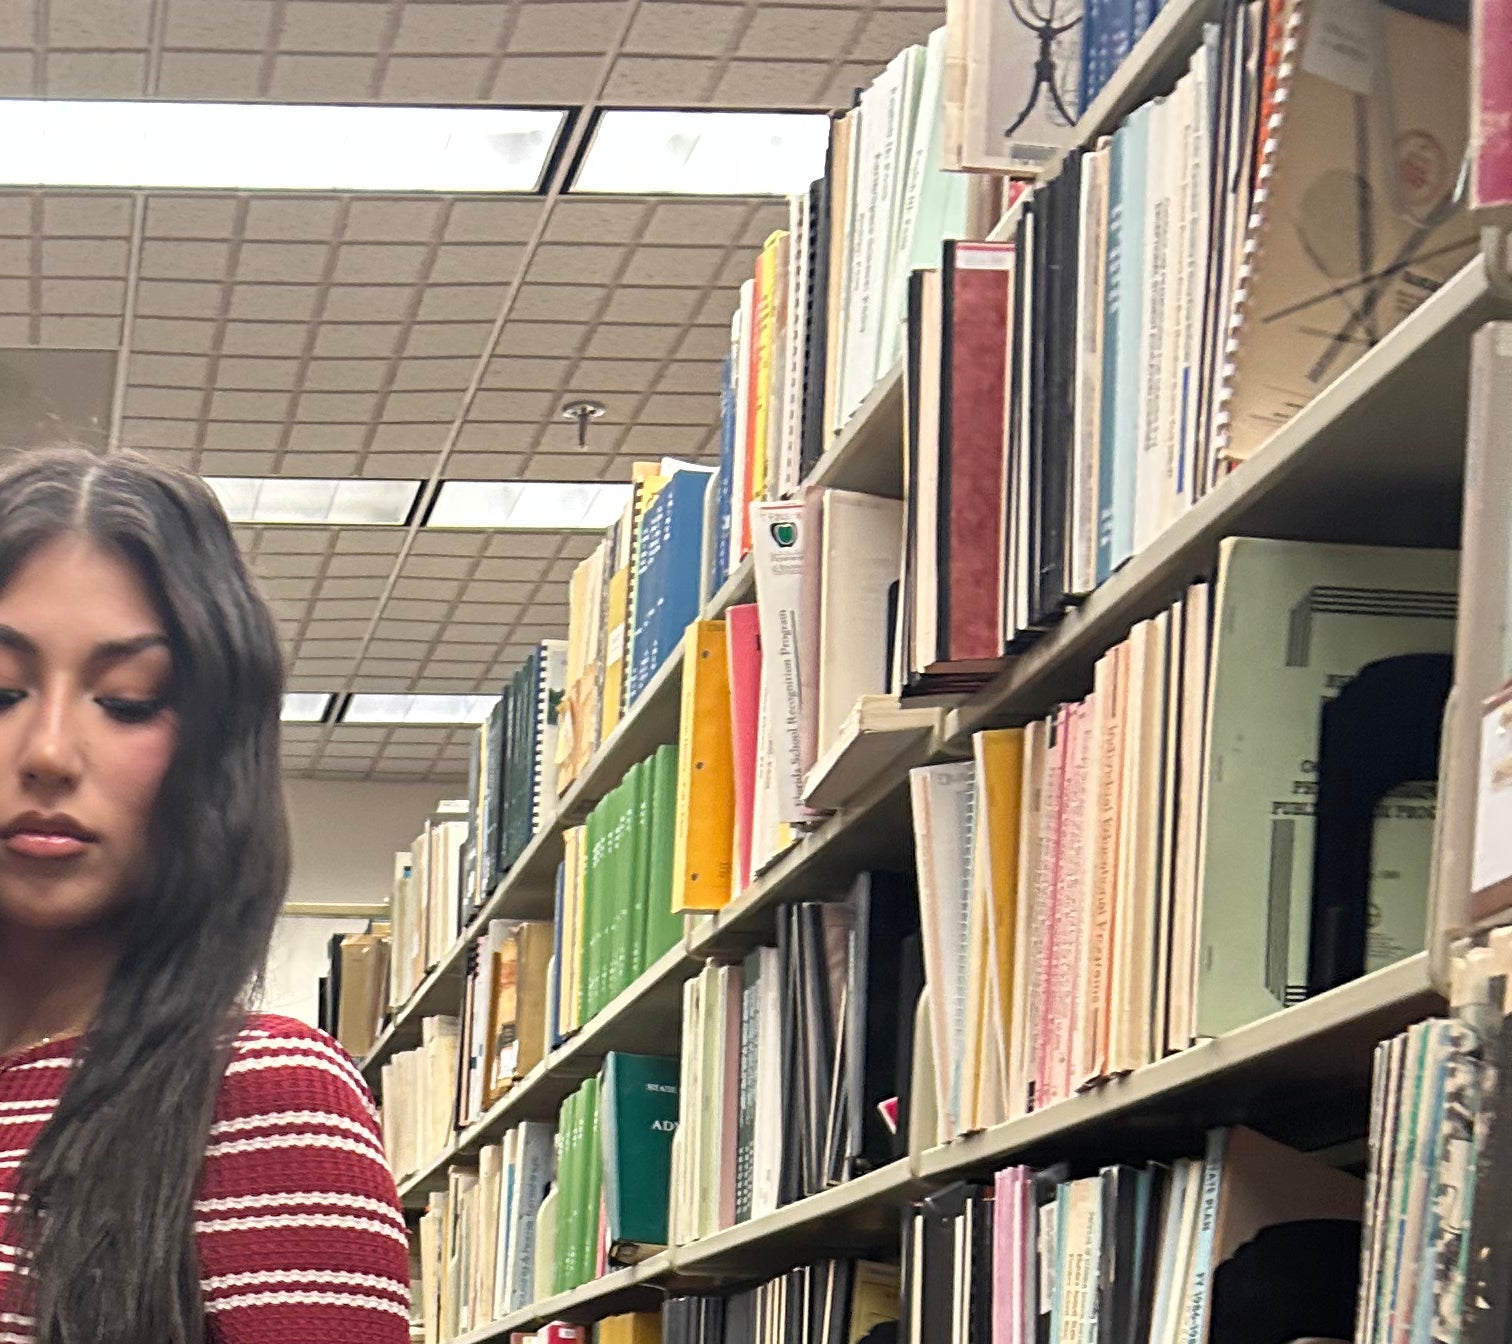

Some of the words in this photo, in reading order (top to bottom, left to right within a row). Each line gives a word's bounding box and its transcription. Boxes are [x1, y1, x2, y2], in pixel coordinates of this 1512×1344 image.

[779, 609, 792, 656] Program
[784, 659, 799, 725] Recognition
[788, 728, 800, 765] School
[1202, 1199, 1214, 1232] PLAN
